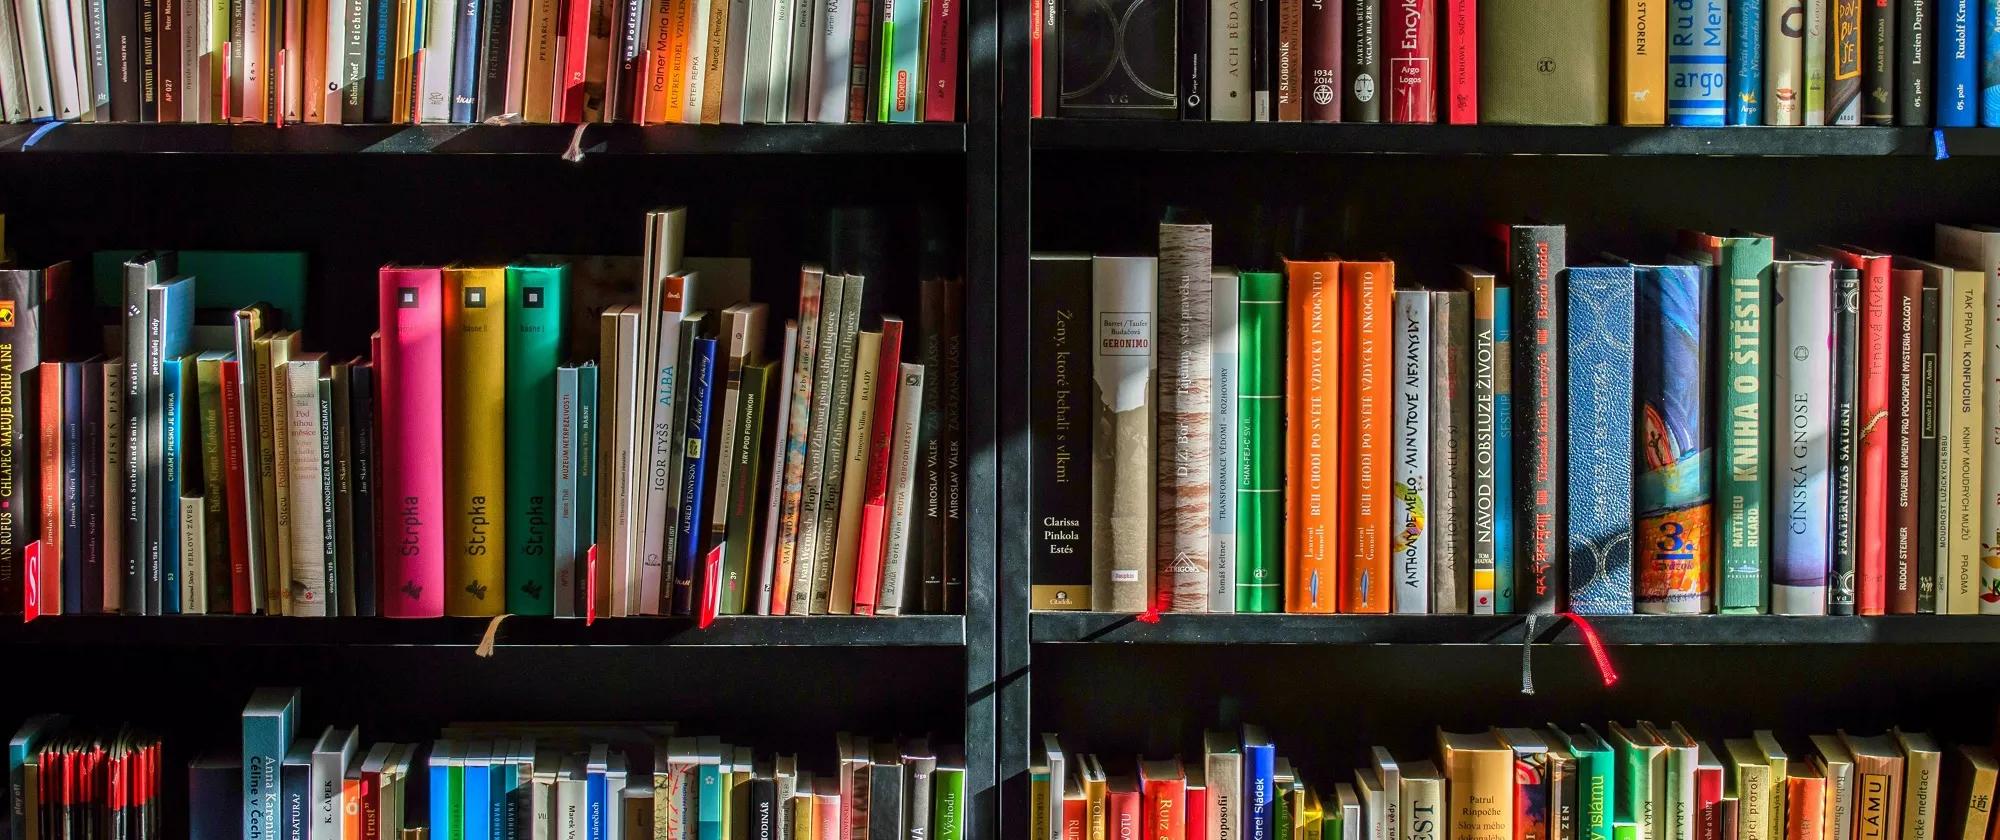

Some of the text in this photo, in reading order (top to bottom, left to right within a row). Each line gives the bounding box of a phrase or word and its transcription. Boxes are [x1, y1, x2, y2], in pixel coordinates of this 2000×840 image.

[1225, 1, 1239, 77] ACH BĚDA
[1673, 0, 1692, 46] Rud
[1703, 0, 1722, 47] Mer
[1955, 24, 1966, 59] Rudolf
[653, 17, 669, 92] Rainer Maria
[1364, 35, 1374, 66] VÁCLAV
[1877, 18, 1885, 72] MAREK VADAS
[1279, 42, 1289, 104] M. SLOBODNÍK
[1313, 69, 1333, 77] 1934
[1313, 77, 1333, 85] 2014
[1399, 75, 1422, 86] Logos
[1401, 65, 1420, 75] Argo
[1674, 74, 1724, 96] argo
[689, 81, 698, 107] PETER
[1312, 271, 1326, 334] INKOGNITO
[1361, 271, 1375, 334] INKOGNITO
[1537, 282, 1550, 321] Bardo
[1868, 274, 1886, 319] dívka
[151, 339, 161, 376] peter šulej
[1102, 338, 1149, 348] GERONIMO
[1963, 289, 1974, 413] TAK PRAVIL KONFUCIUS
[2, 362, 12, 371] A
[861, 369, 871, 401] BALADY
[1055, 351, 1069, 389] ktoré
[1728, 277, 1759, 482] KNIHA O ŠTĚSTÍ
[0, 371, 13, 405] DÚHU
[1898, 296, 1912, 507] STAVEBNÍ KAMENY PRO POCHOPENÍ MYSTERIA GOLGOTY
[167, 417, 174, 426] JE
[581, 405, 589, 429] BÁSNE
[654, 365, 674, 491] IGOR TYŠŠ ALBA
[741, 393, 754, 464] KRV POD FIGOVNÍKOM
[857, 411, 867, 435] Villon
[1055, 392, 1069, 430] behali
[1404, 392, 1419, 468] MINUTOVÉ
[1536, 351, 1552, 482] Tibetská kniha mrtvých
[128, 362, 138, 521] James Sutherland-Smith Pazúrik
[926, 438, 938, 468] VÁLEK
[946, 438, 959, 468] VÁLEK
[1311, 434, 1323, 449] PO
[1361, 434, 1373, 449] PO
[1474, 329, 1492, 543] NÁVOD K OBSLUZE ŽIVOTA
[1963, 425, 1973, 454] KNIHY
[0, 447, 13, 497] CHLAPEC
[166, 457, 174, 482] CHRÁM
[1055, 443, 1069, 482] vlkmi
[1216, 367, 1228, 595] Tomáš Keltner TRANSFORMACE VĚDOMÍ ROZHOVORY
[1309, 453, 1323, 490] CHODÍ
[1359, 453, 1373, 490] CHODÍ
[1789, 392, 1809, 535] ČÍNSKÁ GNOSE
[1837, 401, 1850, 556] FRATERNITAS SATURNI
[682, 463, 696, 534] ALFRED TENNYSON
[928, 469, 938, 518] MIROSLAV
[948, 469, 959, 519] MIROSLAV
[1405, 477, 1417, 513] MELLO
[1961, 455, 1974, 511] MOUDRÝCH
[0, 511, 12, 545] RÚFUS
[396, 496, 423, 556] Štrpka
[463, 495, 489, 556] Štrpka
[520, 495, 548, 556] Štrpka
[1043, 516, 1080, 528] Clarissa
[1044, 530, 1080, 541] Pinkola
[1732, 495, 1744, 548] MATTHIEU
[1747, 508, 1759, 548] RICARD
[1938, 503, 1947, 548] MOUDROST
[890, 520, 902, 564] Boris Vian
[1050, 544, 1074, 554] Estés
[1898, 526, 1908, 591] RUDOLF STEINER
[1960, 553, 1970, 595] PRAGMA
[264, 756, 275, 788] Anna
[321, 780, 332, 824] K. ČAPEK
[1253, 777, 1265, 813] Sládek
[1469, 796, 1494, 804] Patrul
[1587, 775, 1604, 828] islámu
[1644, 800, 1652, 822] KARA
[1676, 800, 1684, 822] KARA
[1748, 775, 1759, 815] prorok
[1862, 780, 1882, 837] LÁMU
[1917, 769, 1930, 816] meditace
[591, 801, 600, 835] nárečiach
[943, 793, 956, 835] Východu
[1387, 803, 1397, 823] vědy
[1561, 804, 1570, 829] ZEN
